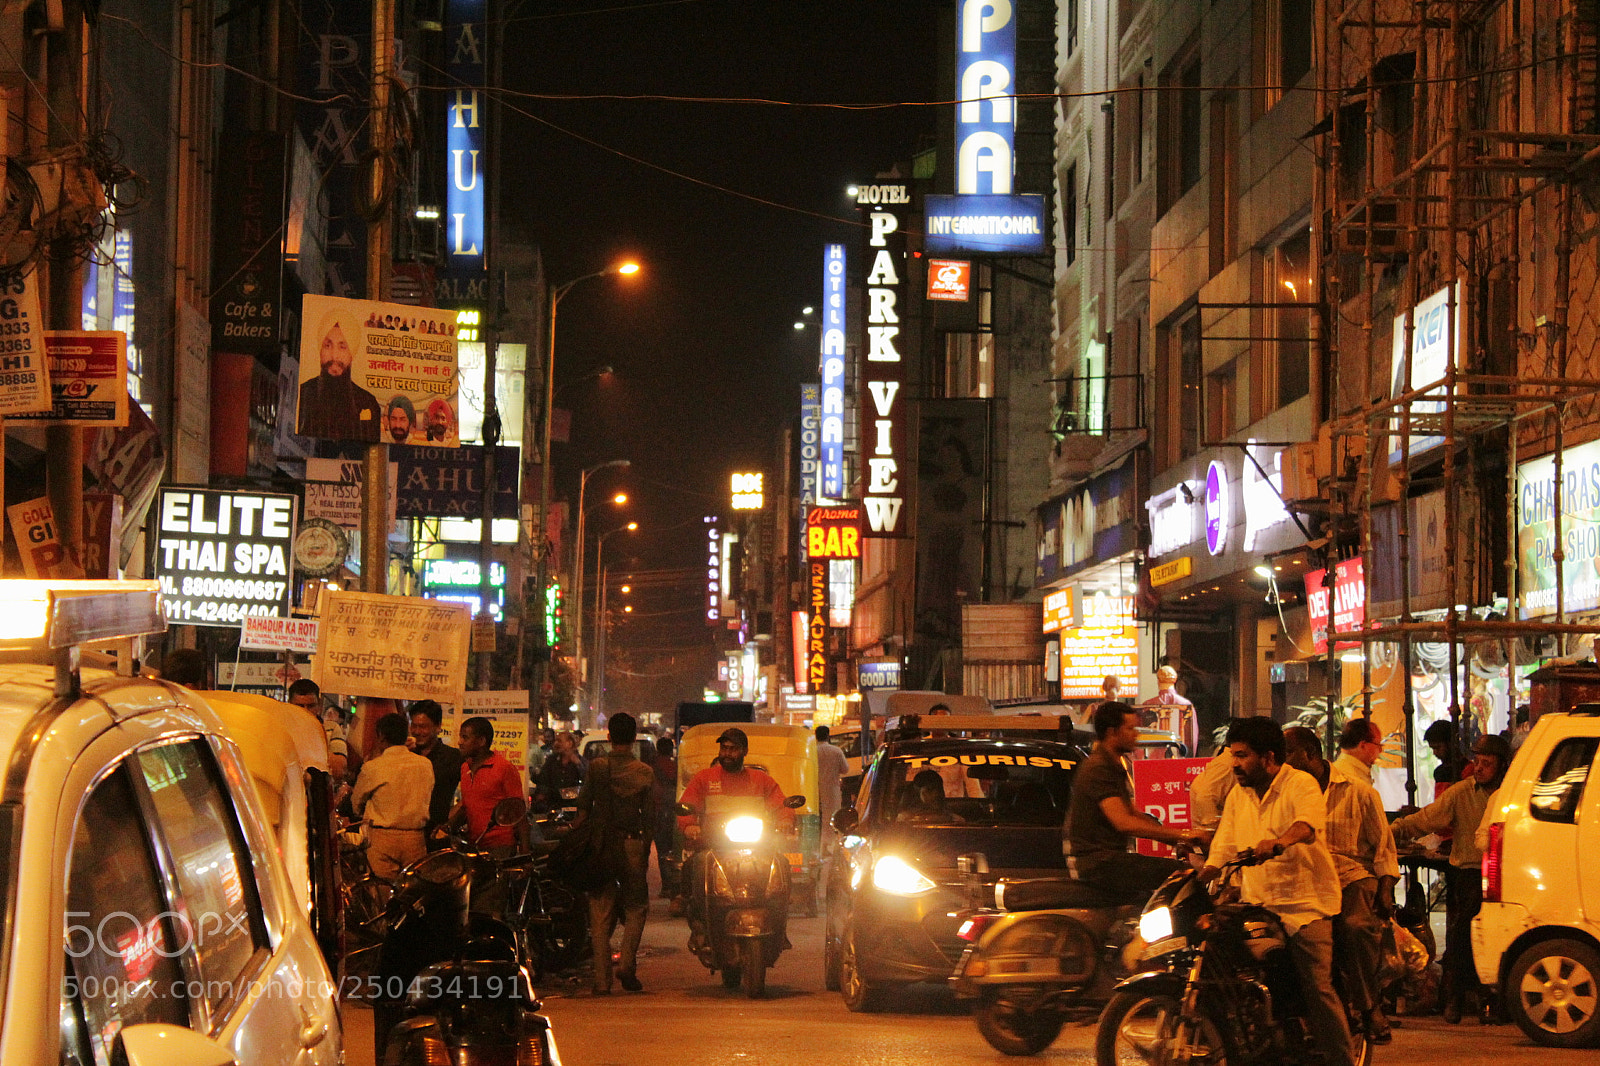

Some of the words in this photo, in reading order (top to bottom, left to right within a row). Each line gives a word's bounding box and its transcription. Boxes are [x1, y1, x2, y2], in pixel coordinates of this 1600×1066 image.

[857, 185, 910, 204] HOTEL
[928, 216, 1041, 235] INTERNATIONAL
[830, 244, 842, 325] HOTEL
[867, 212, 900, 363] PARK
[224, 302, 253, 319] Cafe
[263, 302, 272, 317] &
[224, 322, 272, 338] Bakers
[823, 330, 845, 443] APRA
[824, 447, 838, 495] INN
[863, 381, 903, 532] VIEW
[161, 492, 291, 538] ELITE
[808, 507, 859, 525] Aroma
[808, 526, 859, 557] BAR
[160, 539, 227, 573] THAI
[233, 543, 287, 576] SPA
[182, 577, 286, 602] 8800960687
[708, 528, 720, 620] CLASSIC
[246, 617, 284, 634] BAHADUR
[285, 621, 296, 634] KA
[297, 622, 317, 637] ROTI
[810, 563, 826, 691] RESTAURANT
[860, 672, 885, 687] GOOD
[904, 754, 1077, 770] TOURIST
